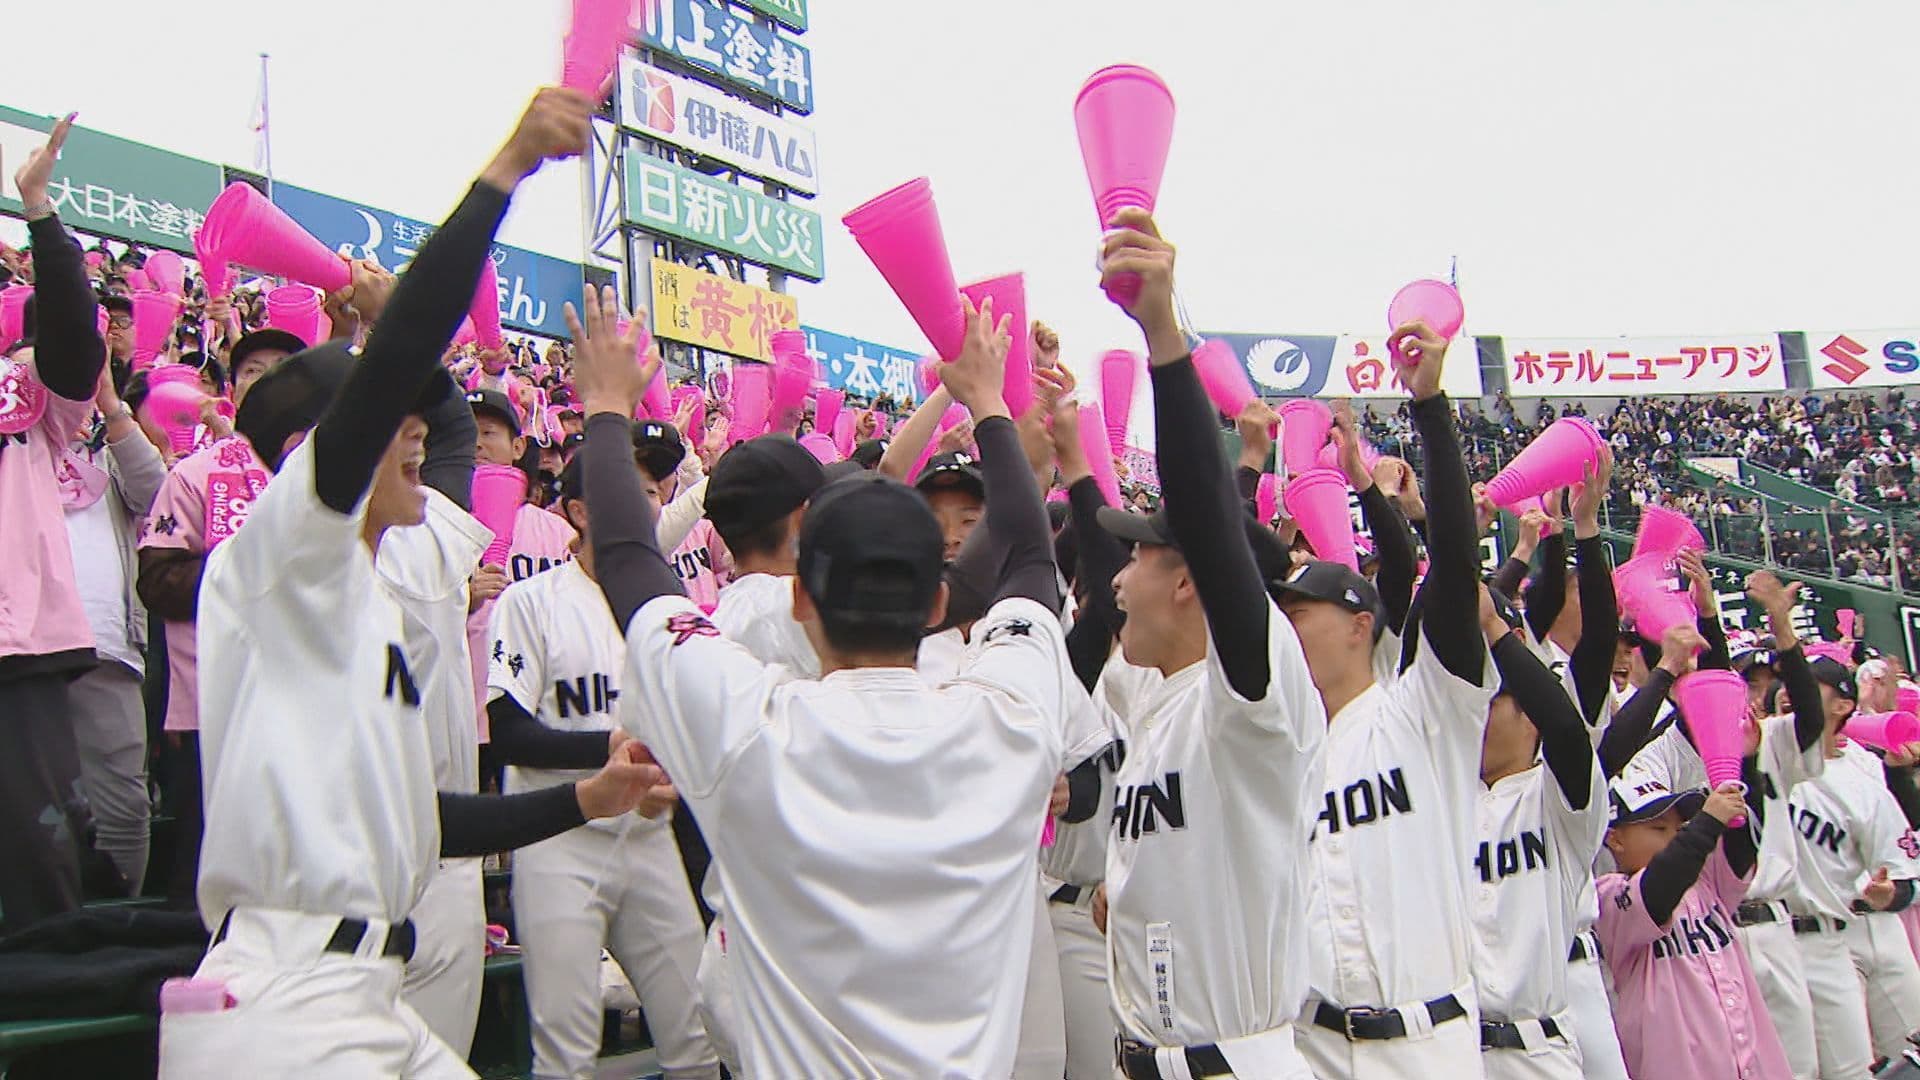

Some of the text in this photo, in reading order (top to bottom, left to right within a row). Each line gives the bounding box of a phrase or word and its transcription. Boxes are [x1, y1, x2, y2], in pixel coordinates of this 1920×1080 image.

[684, 97, 813, 178] 伊藤ハム
[639, 161, 816, 269] 日新火災
[1513, 344, 1774, 384] ホテルニューアワジ
